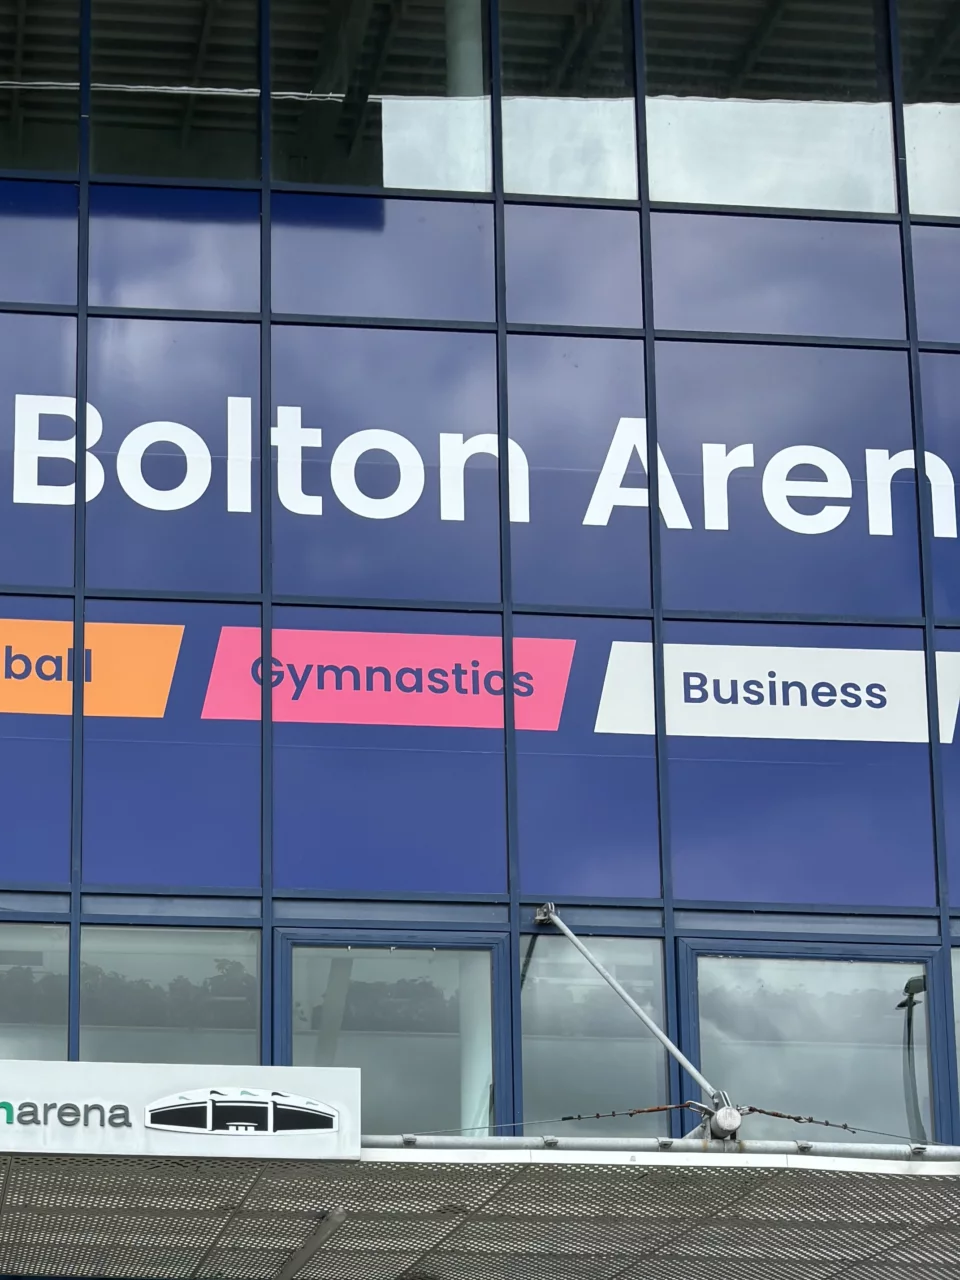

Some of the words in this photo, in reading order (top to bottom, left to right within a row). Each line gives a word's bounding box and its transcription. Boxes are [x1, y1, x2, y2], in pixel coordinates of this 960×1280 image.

[13, 393, 530, 523] Bolton
[582, 417, 958, 538] Aren
[250, 654, 535, 701] Gymnastics
[683, 671, 888, 710] Business
